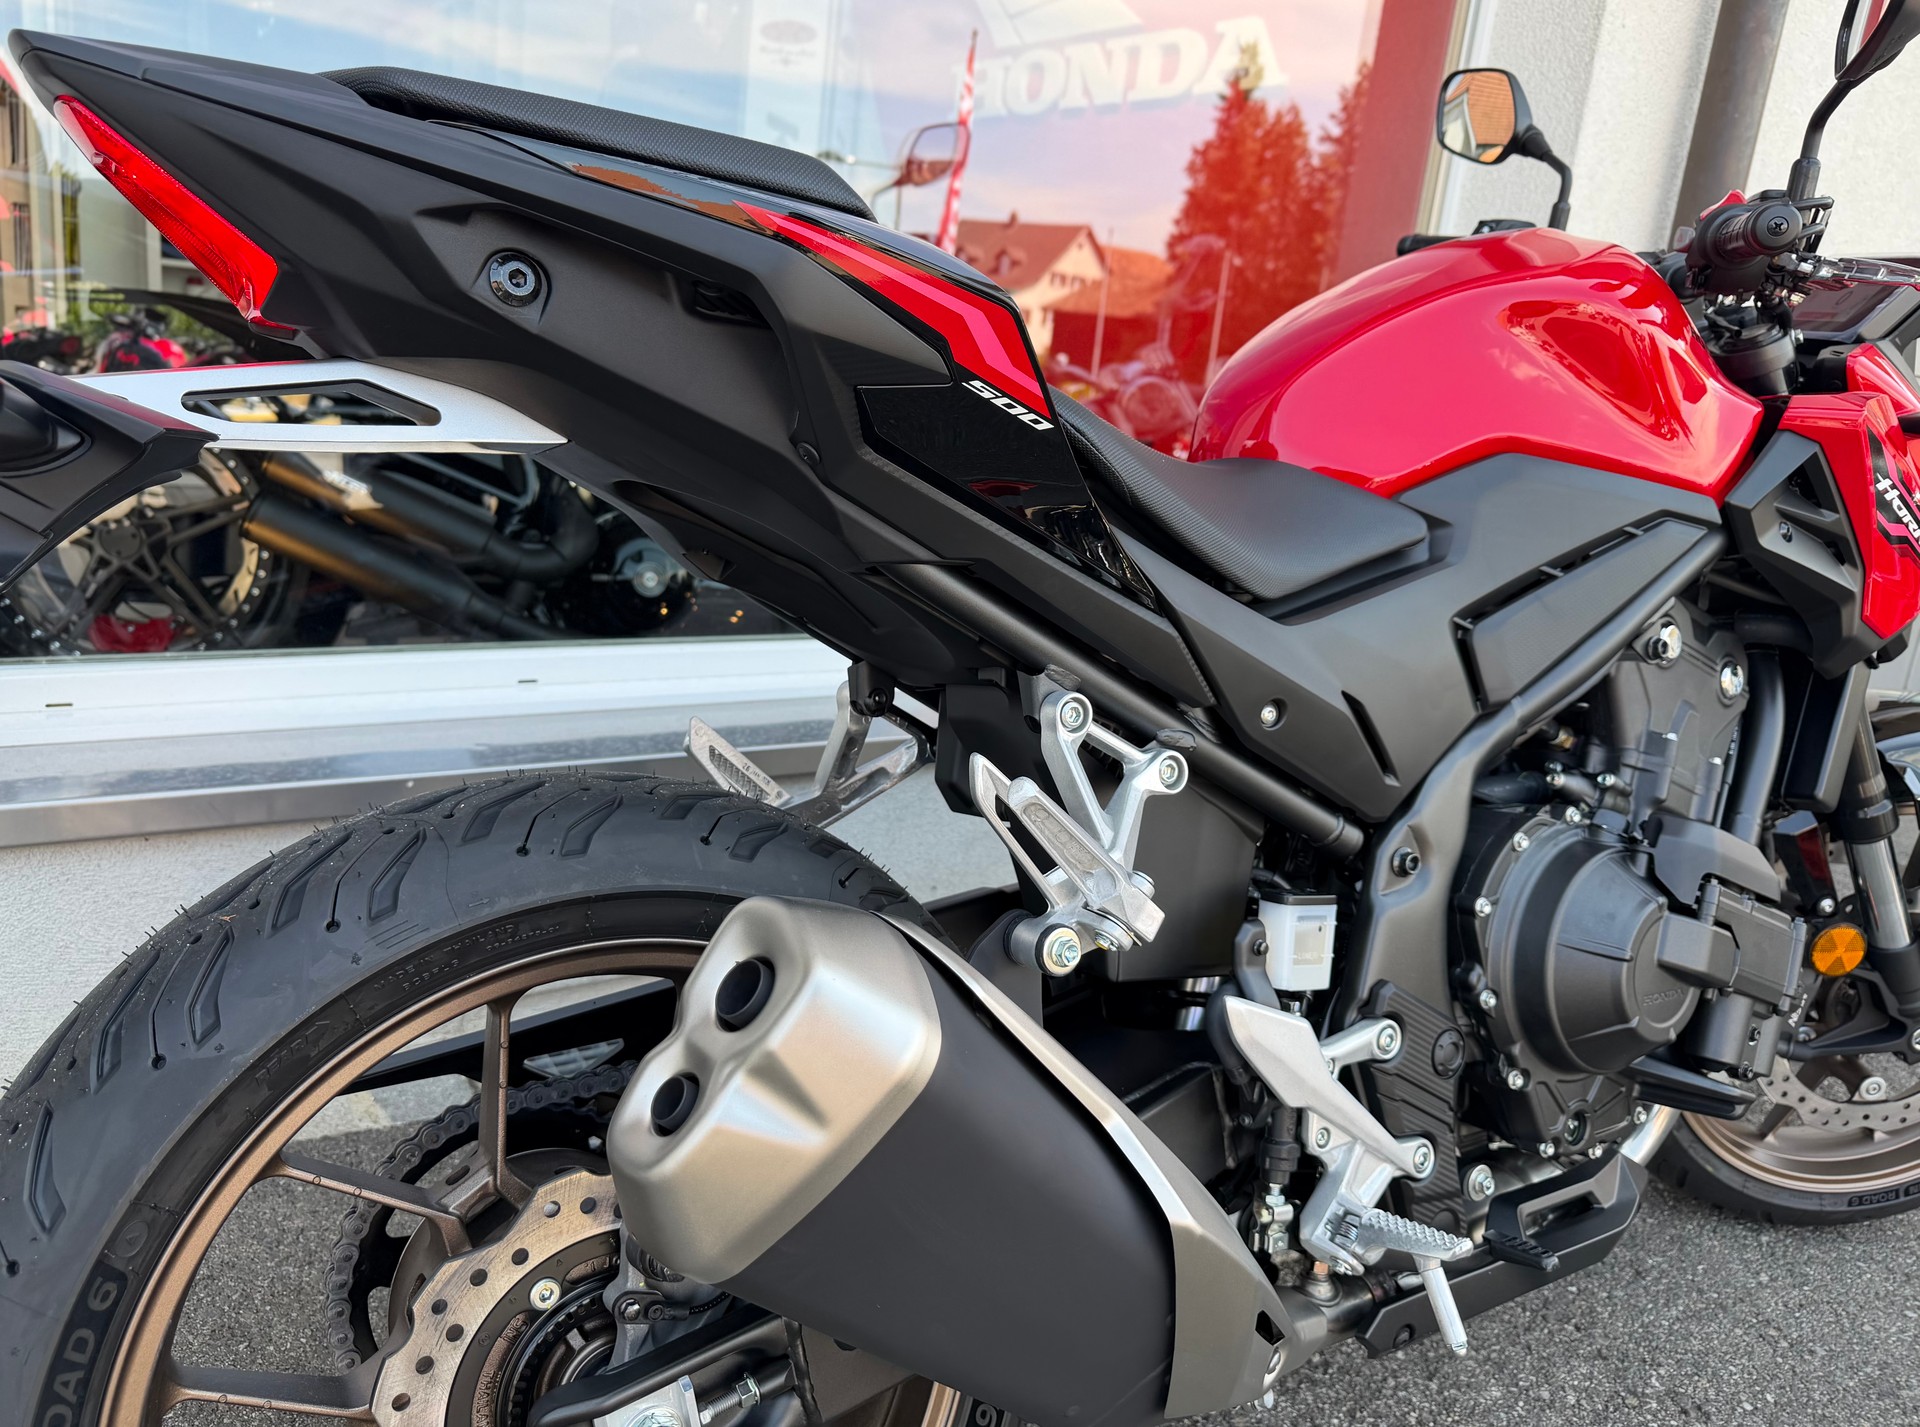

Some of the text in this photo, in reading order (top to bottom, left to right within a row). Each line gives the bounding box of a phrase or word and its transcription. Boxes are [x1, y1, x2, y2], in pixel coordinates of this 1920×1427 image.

[949, 16, 1289, 121] HONDA
[961, 380, 1055, 431] 500
[442, 923, 515, 954] THAILAND
[1862, 1190, 1896, 1205] ROAD
[87, 1277, 118, 1312] 6
